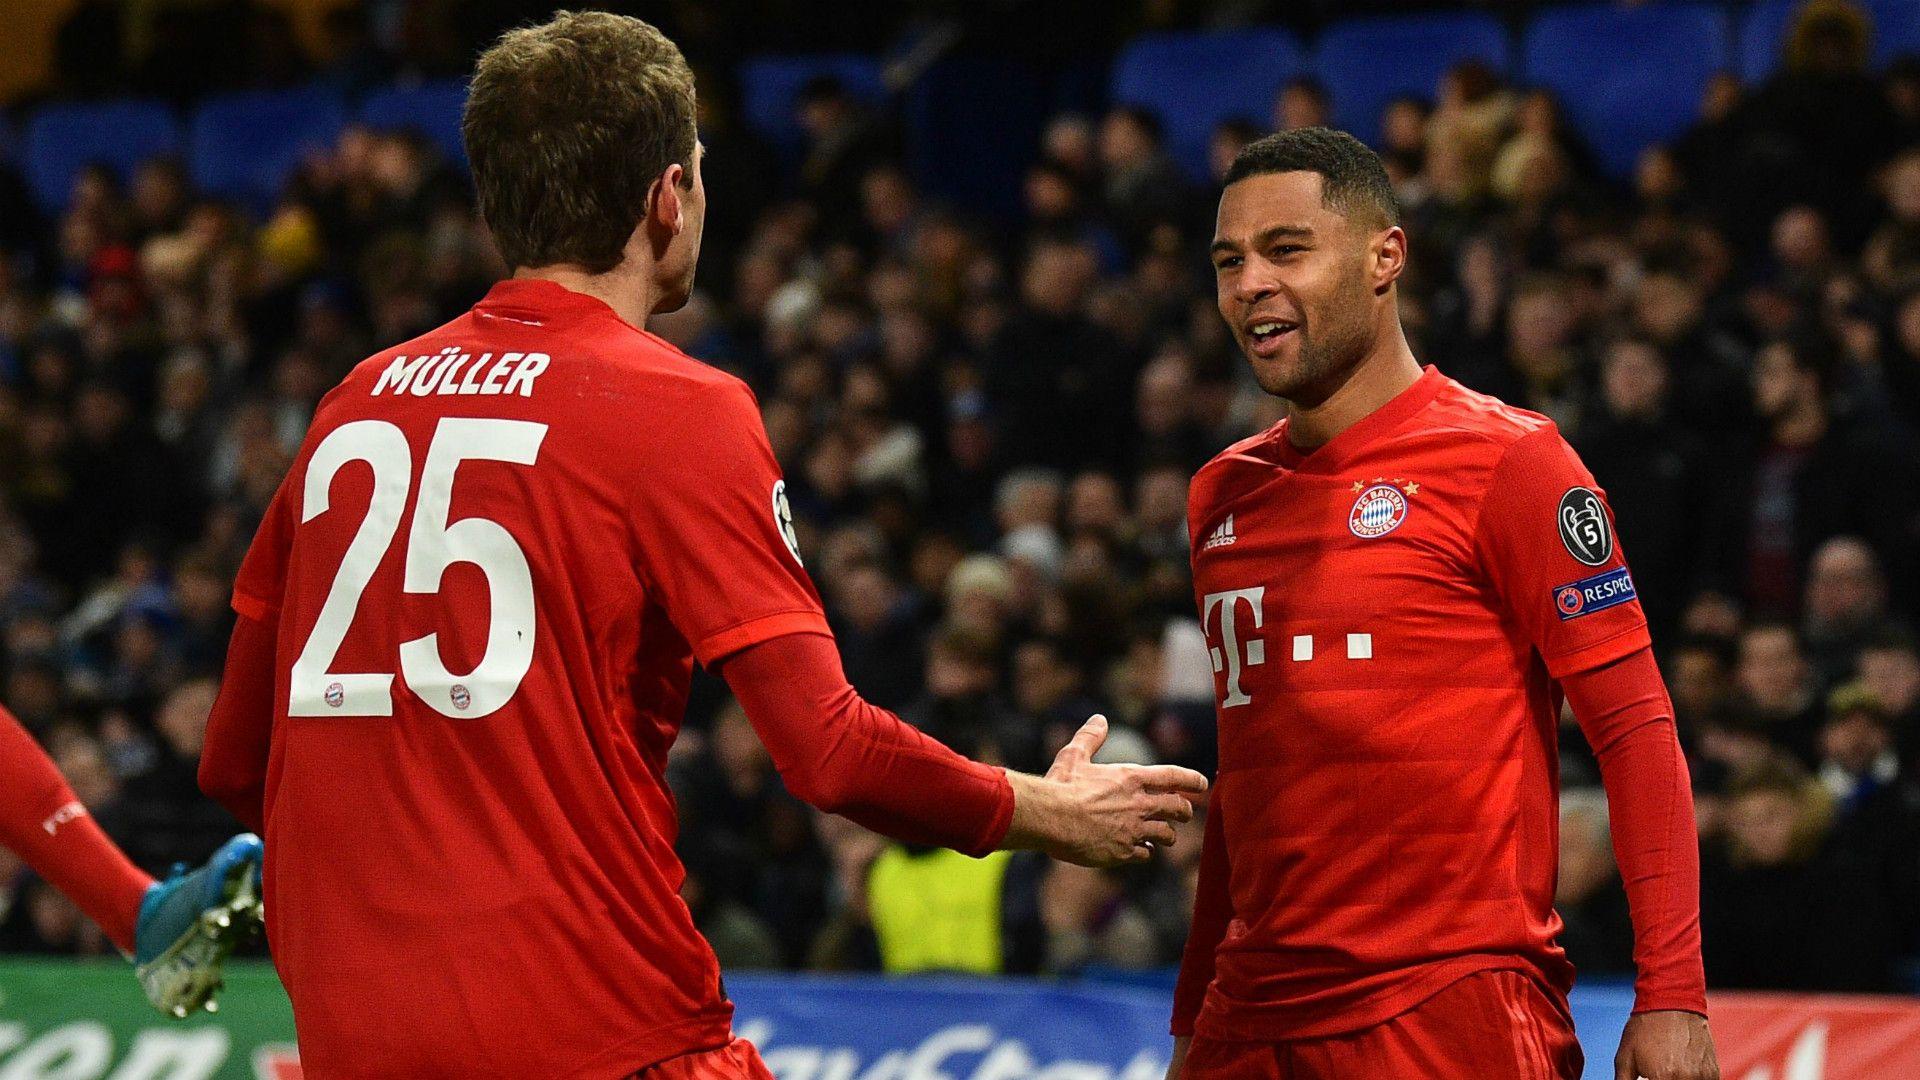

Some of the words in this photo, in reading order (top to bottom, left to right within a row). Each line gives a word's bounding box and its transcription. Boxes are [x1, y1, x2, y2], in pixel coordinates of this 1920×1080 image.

[371, 346, 550, 397] MÜLLER
[1357, 498, 1370, 511] FC
[1370, 489, 1403, 511] BAYERN
[1203, 535, 1237, 551] adidas
[1584, 524, 1598, 545] 5
[288, 416, 548, 719] 25
[1584, 575, 1632, 603] RESPEC
